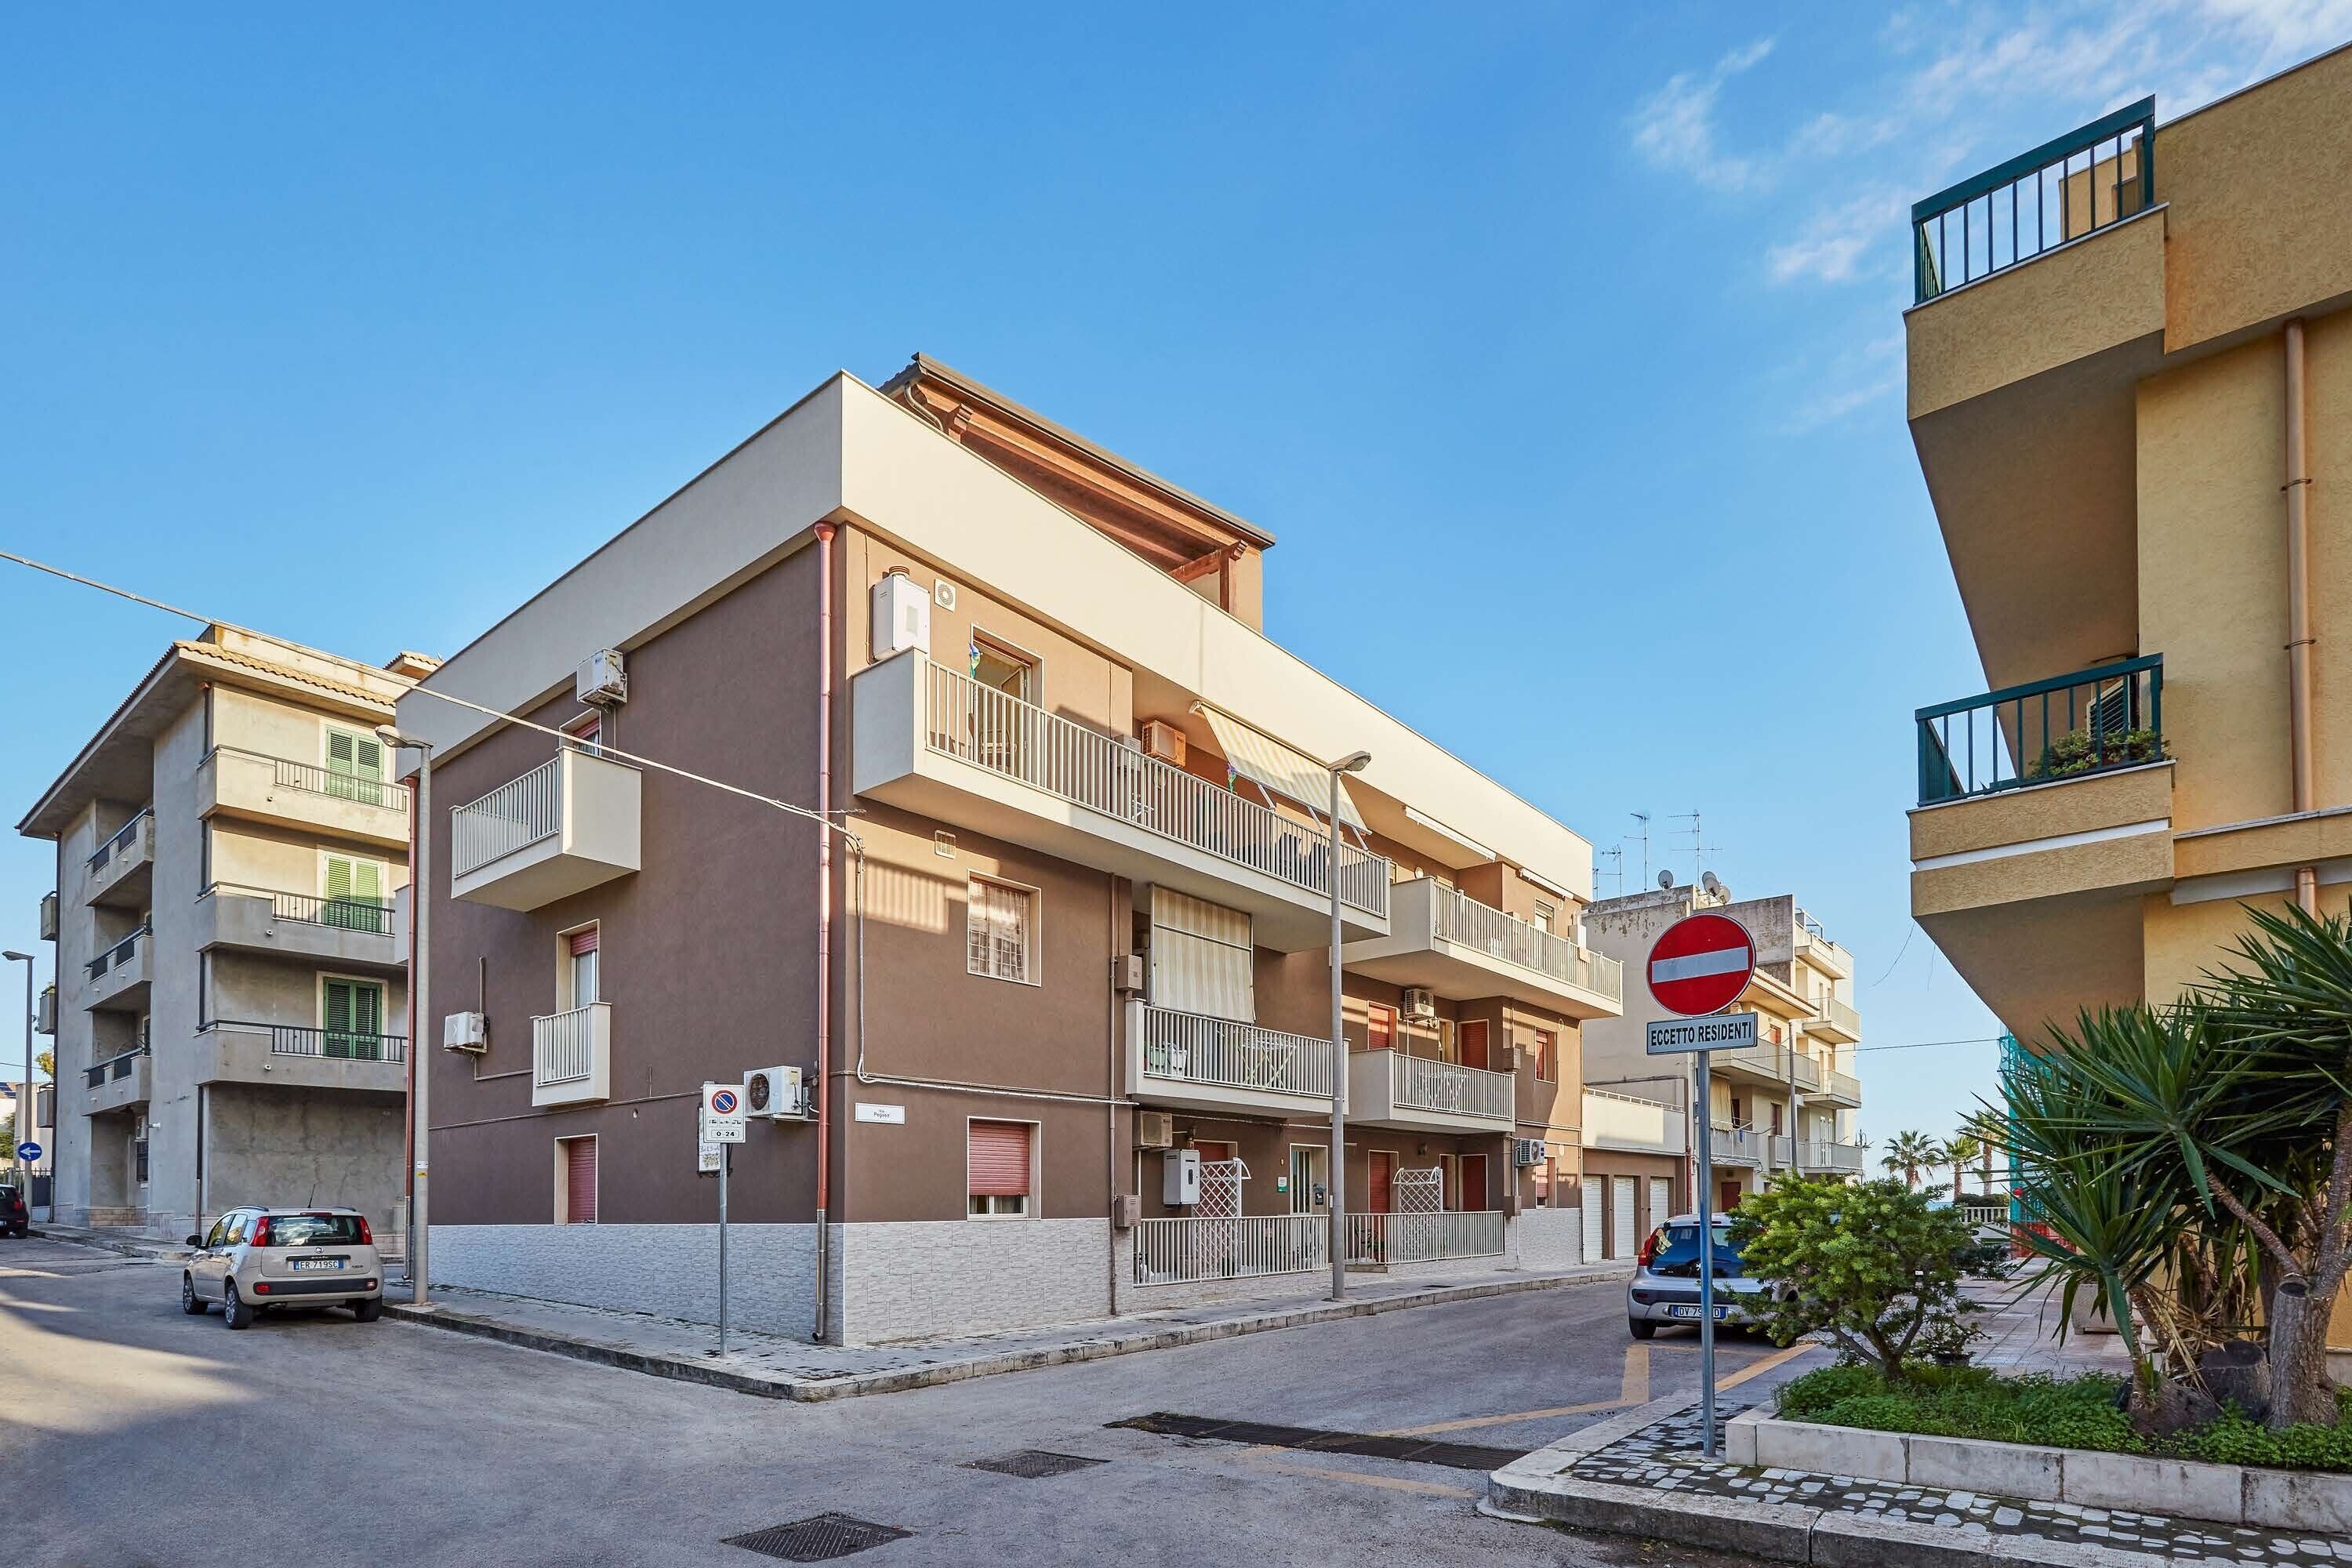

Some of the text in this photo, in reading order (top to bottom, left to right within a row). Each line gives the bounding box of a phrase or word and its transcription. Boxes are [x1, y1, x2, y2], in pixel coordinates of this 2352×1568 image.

[1651, 1022, 1751, 1046] ECCETTO RESIDENTI
[1679, 1307, 1690, 1316] DV
